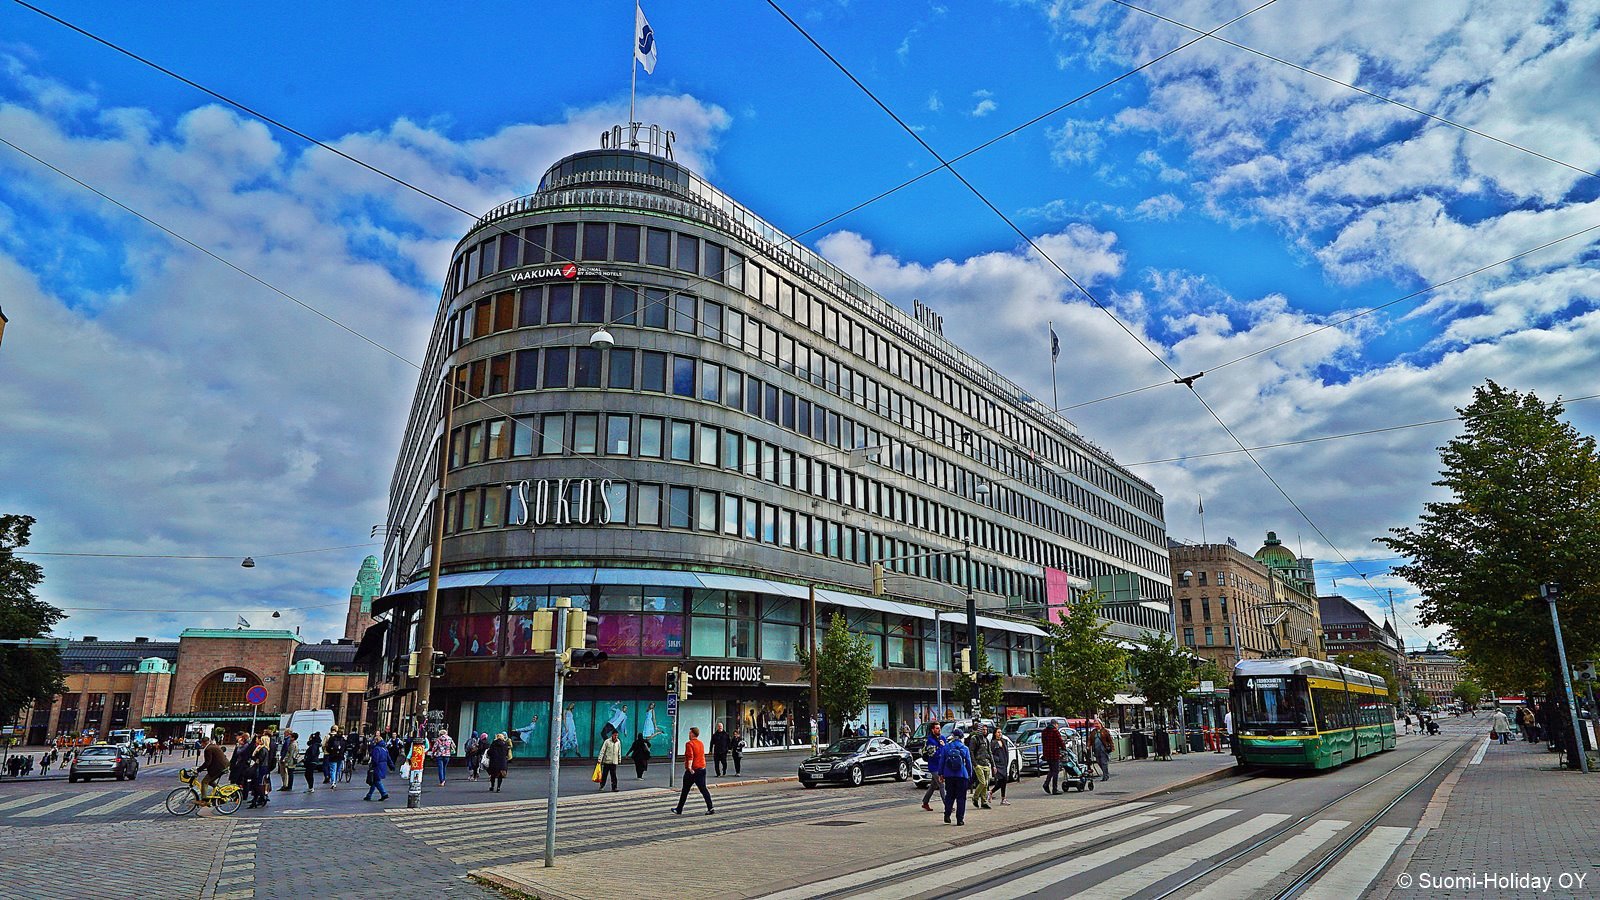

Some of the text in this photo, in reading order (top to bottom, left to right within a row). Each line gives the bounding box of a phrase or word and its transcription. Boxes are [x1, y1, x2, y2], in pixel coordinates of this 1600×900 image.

[511, 268, 562, 282] VAAKUNA
[516, 478, 613, 526] SOKOS
[695, 665, 761, 682] COFFEE HOUSE
[1246, 678, 1254, 689] 4
